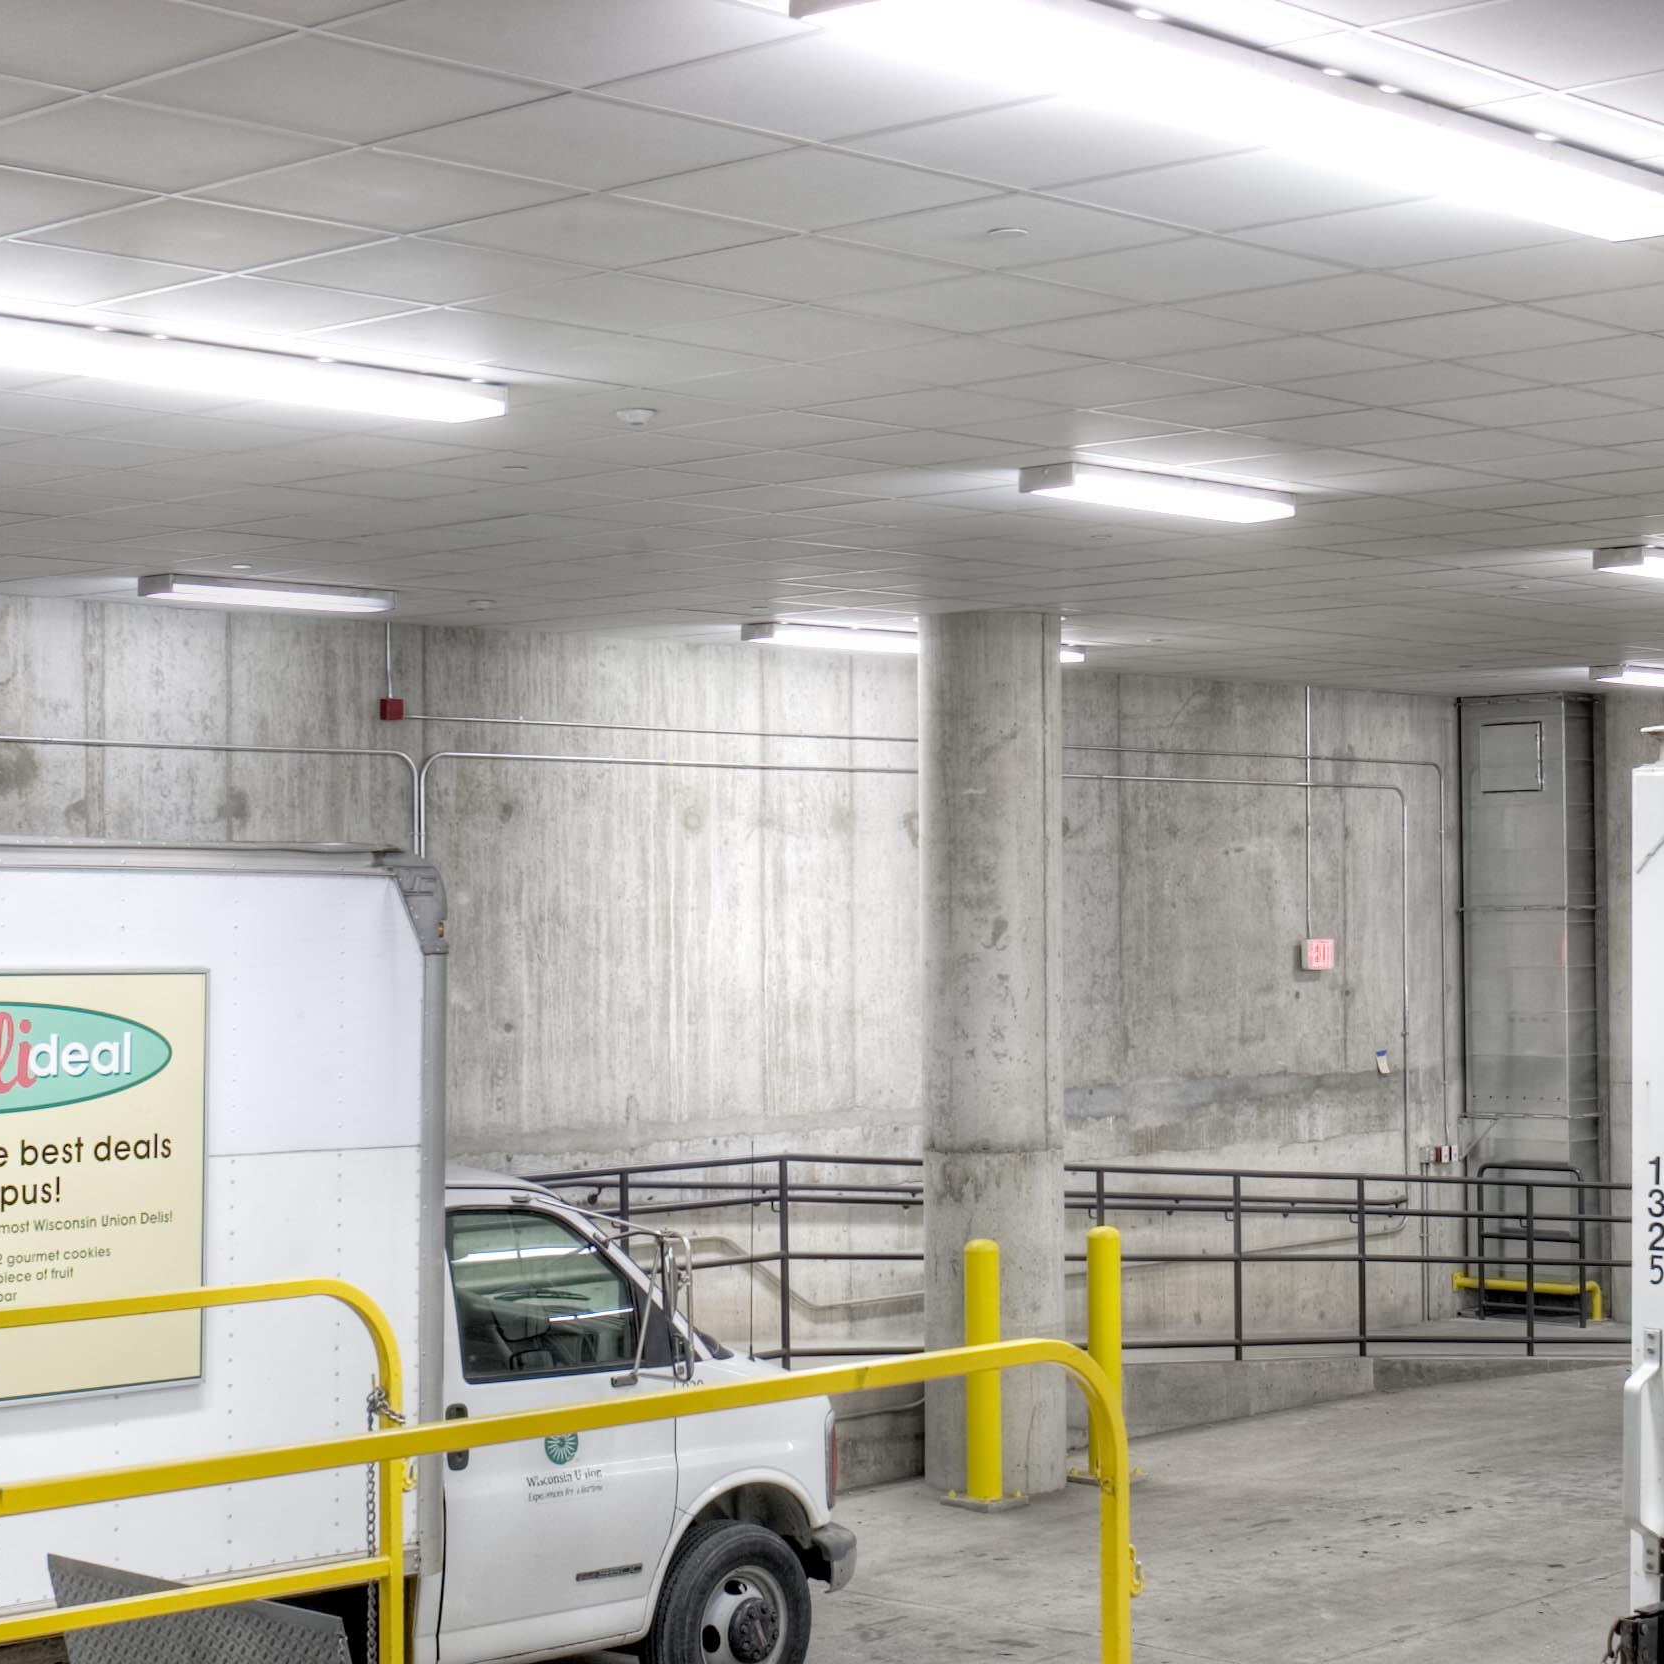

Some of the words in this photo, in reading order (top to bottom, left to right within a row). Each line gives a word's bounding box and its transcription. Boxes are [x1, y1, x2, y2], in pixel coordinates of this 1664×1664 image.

[29, 1031, 133, 1078] deal
[21, 1136, 84, 1167] best
[94, 1133, 173, 1163] deals
[34, 1216, 97, 1232] Wisconsin
[101, 1213, 137, 1228] Union
[140, 1209, 173, 1225] Delis!
[7, 1250, 60, 1267] gourmet
[63, 1246, 112, 1260] cookies
[36, 1268, 48, 1280] of
[50, 1267, 74, 1280] fruit
